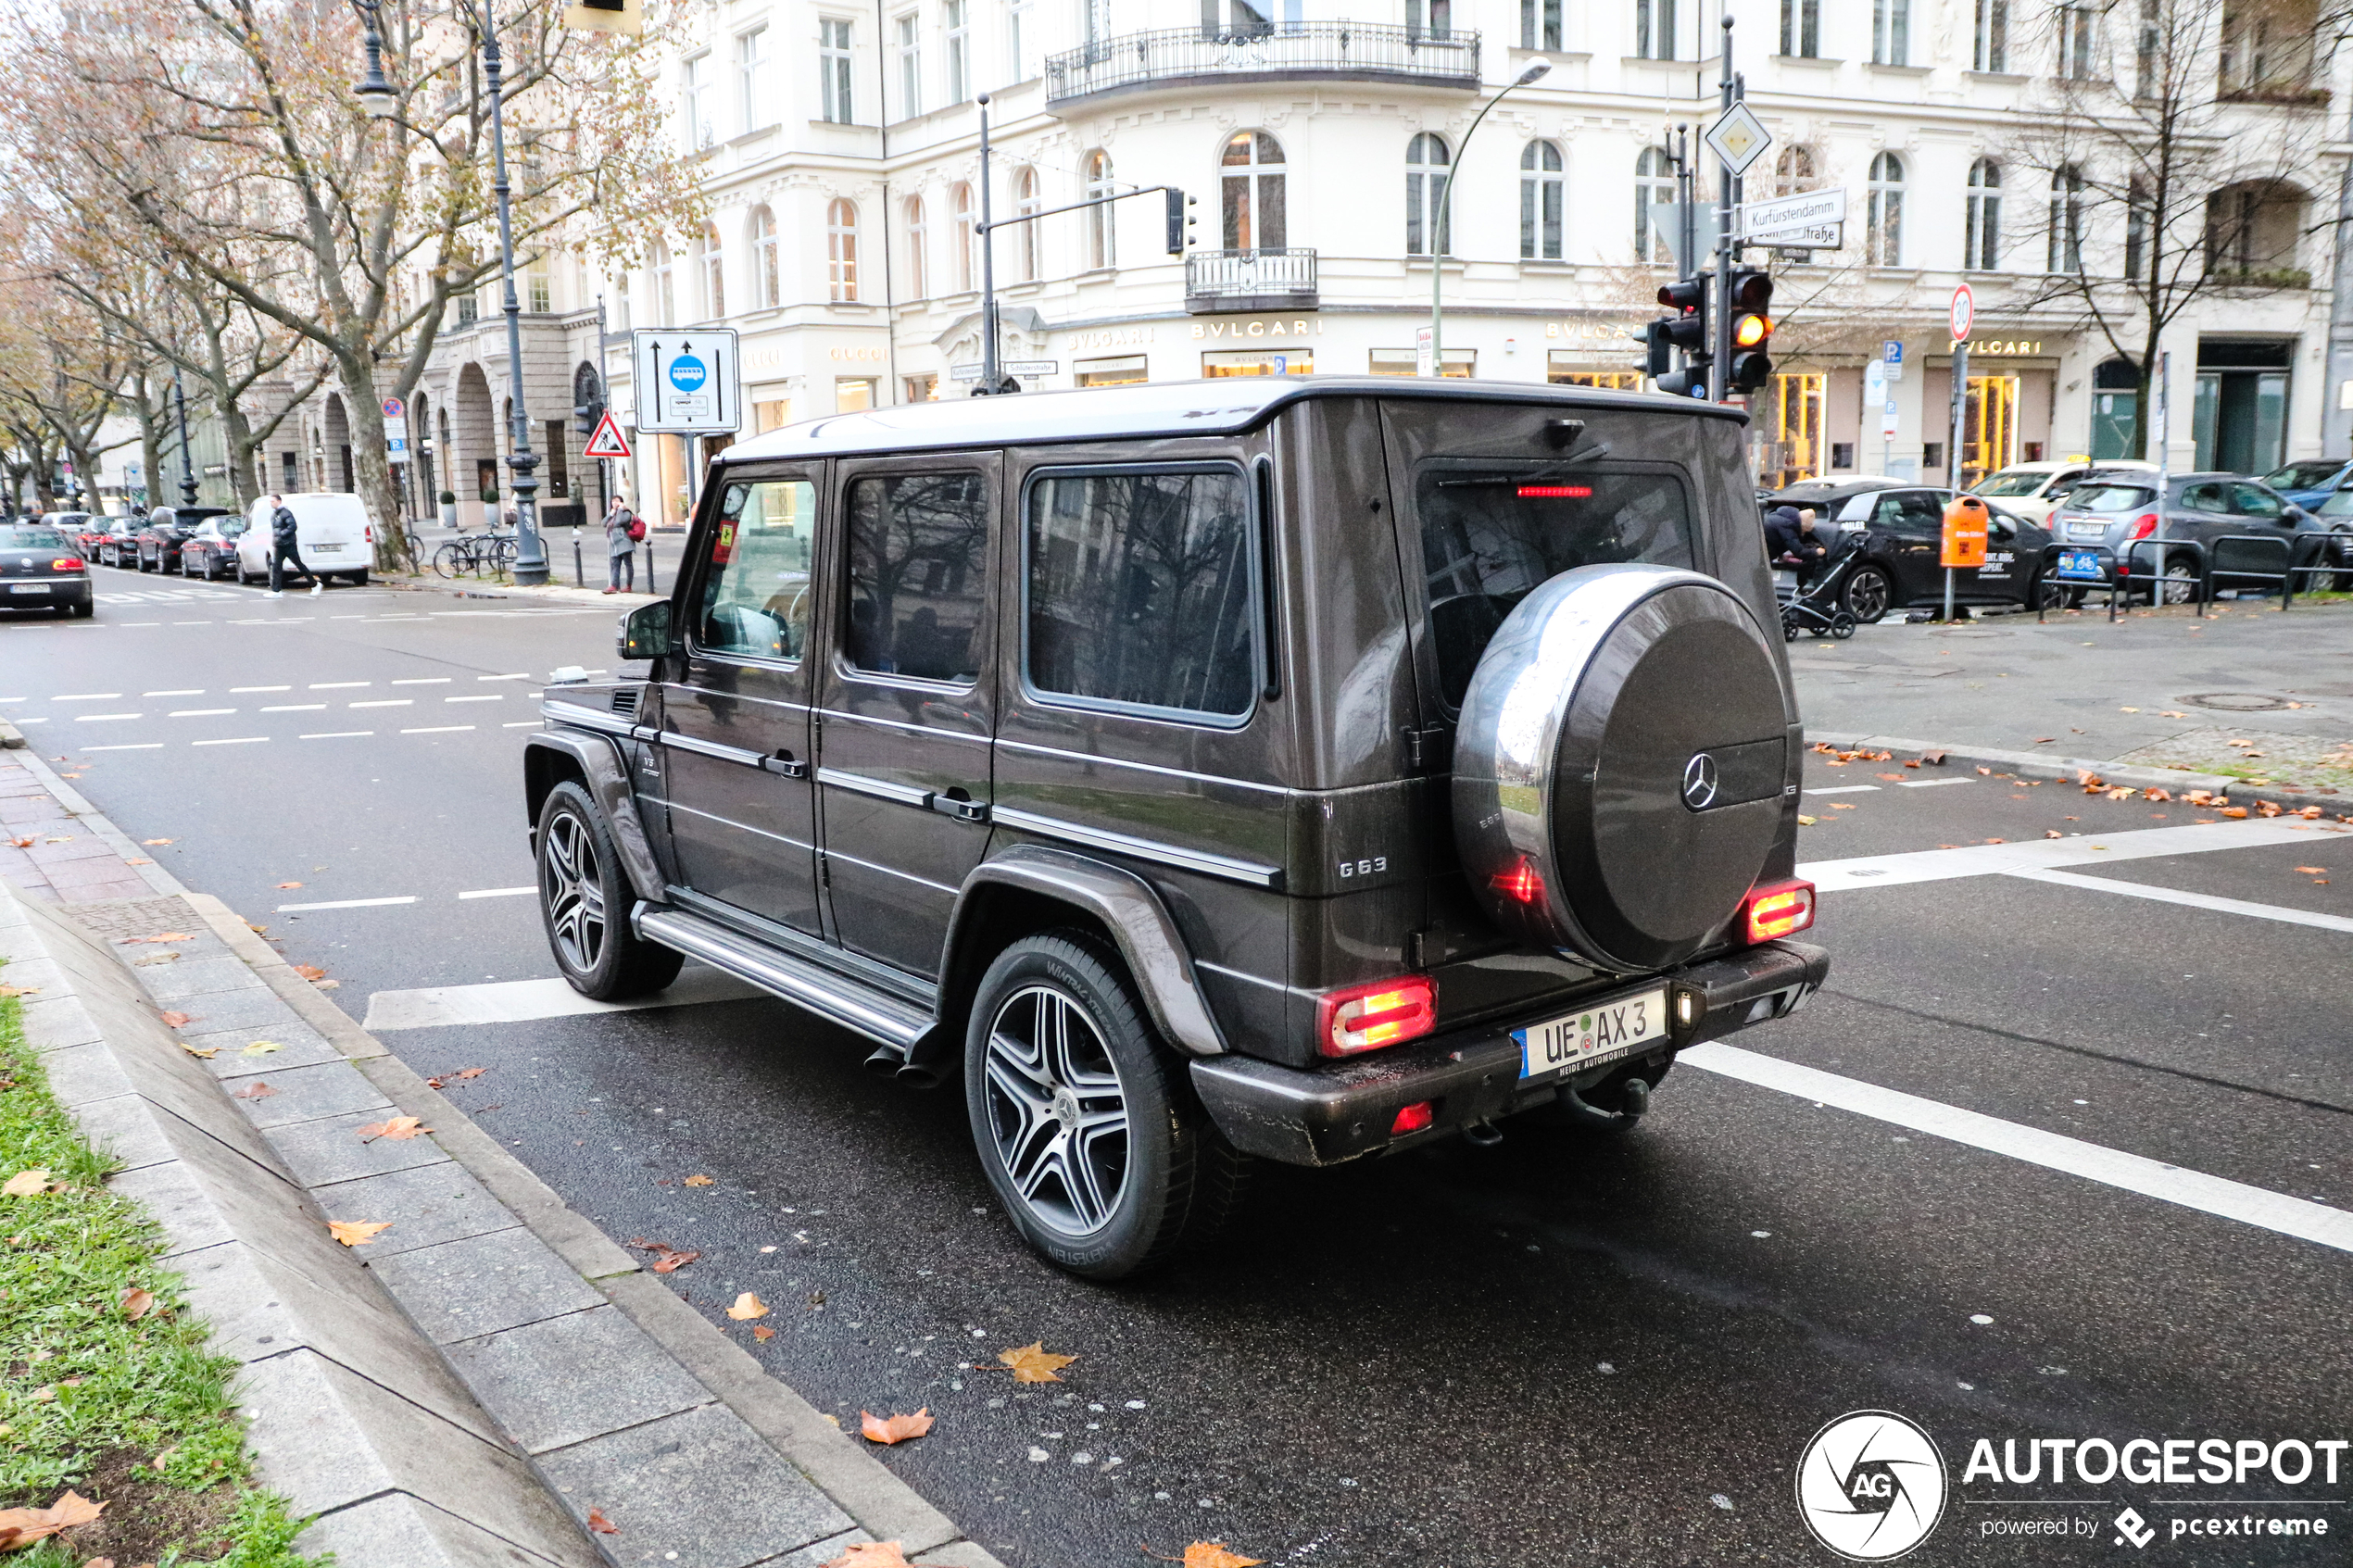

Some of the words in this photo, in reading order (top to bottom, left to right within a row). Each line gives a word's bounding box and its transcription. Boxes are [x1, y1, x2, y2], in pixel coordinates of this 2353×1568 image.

[1752, 202, 1834, 227] Kurfürstendamm
[1955, 300, 1969, 325] 30
[1067, 327, 1154, 350] BVLGARI
[1190, 319, 1323, 339] BVLGARI
[1545, 322, 1642, 339] BVLGA
[744, 349, 780, 368] GUCCI
[830, 347, 887, 360] GUCCI
[1010, 363, 1051, 371] Schlüterstraße
[1095, 361, 1123, 370] BVLGARI
[1985, 553, 1998, 562] ENT.
[1998, 553, 2015, 562] RIDE.
[1545, 1020, 1579, 1063] UE
[1596, 1006, 1628, 1048] AX
[1633, 1000, 1647, 1036] 3
[1559, 1062, 1580, 1076] HEIDE
[1584, 1047, 1629, 1067] AUTOMOBILE
